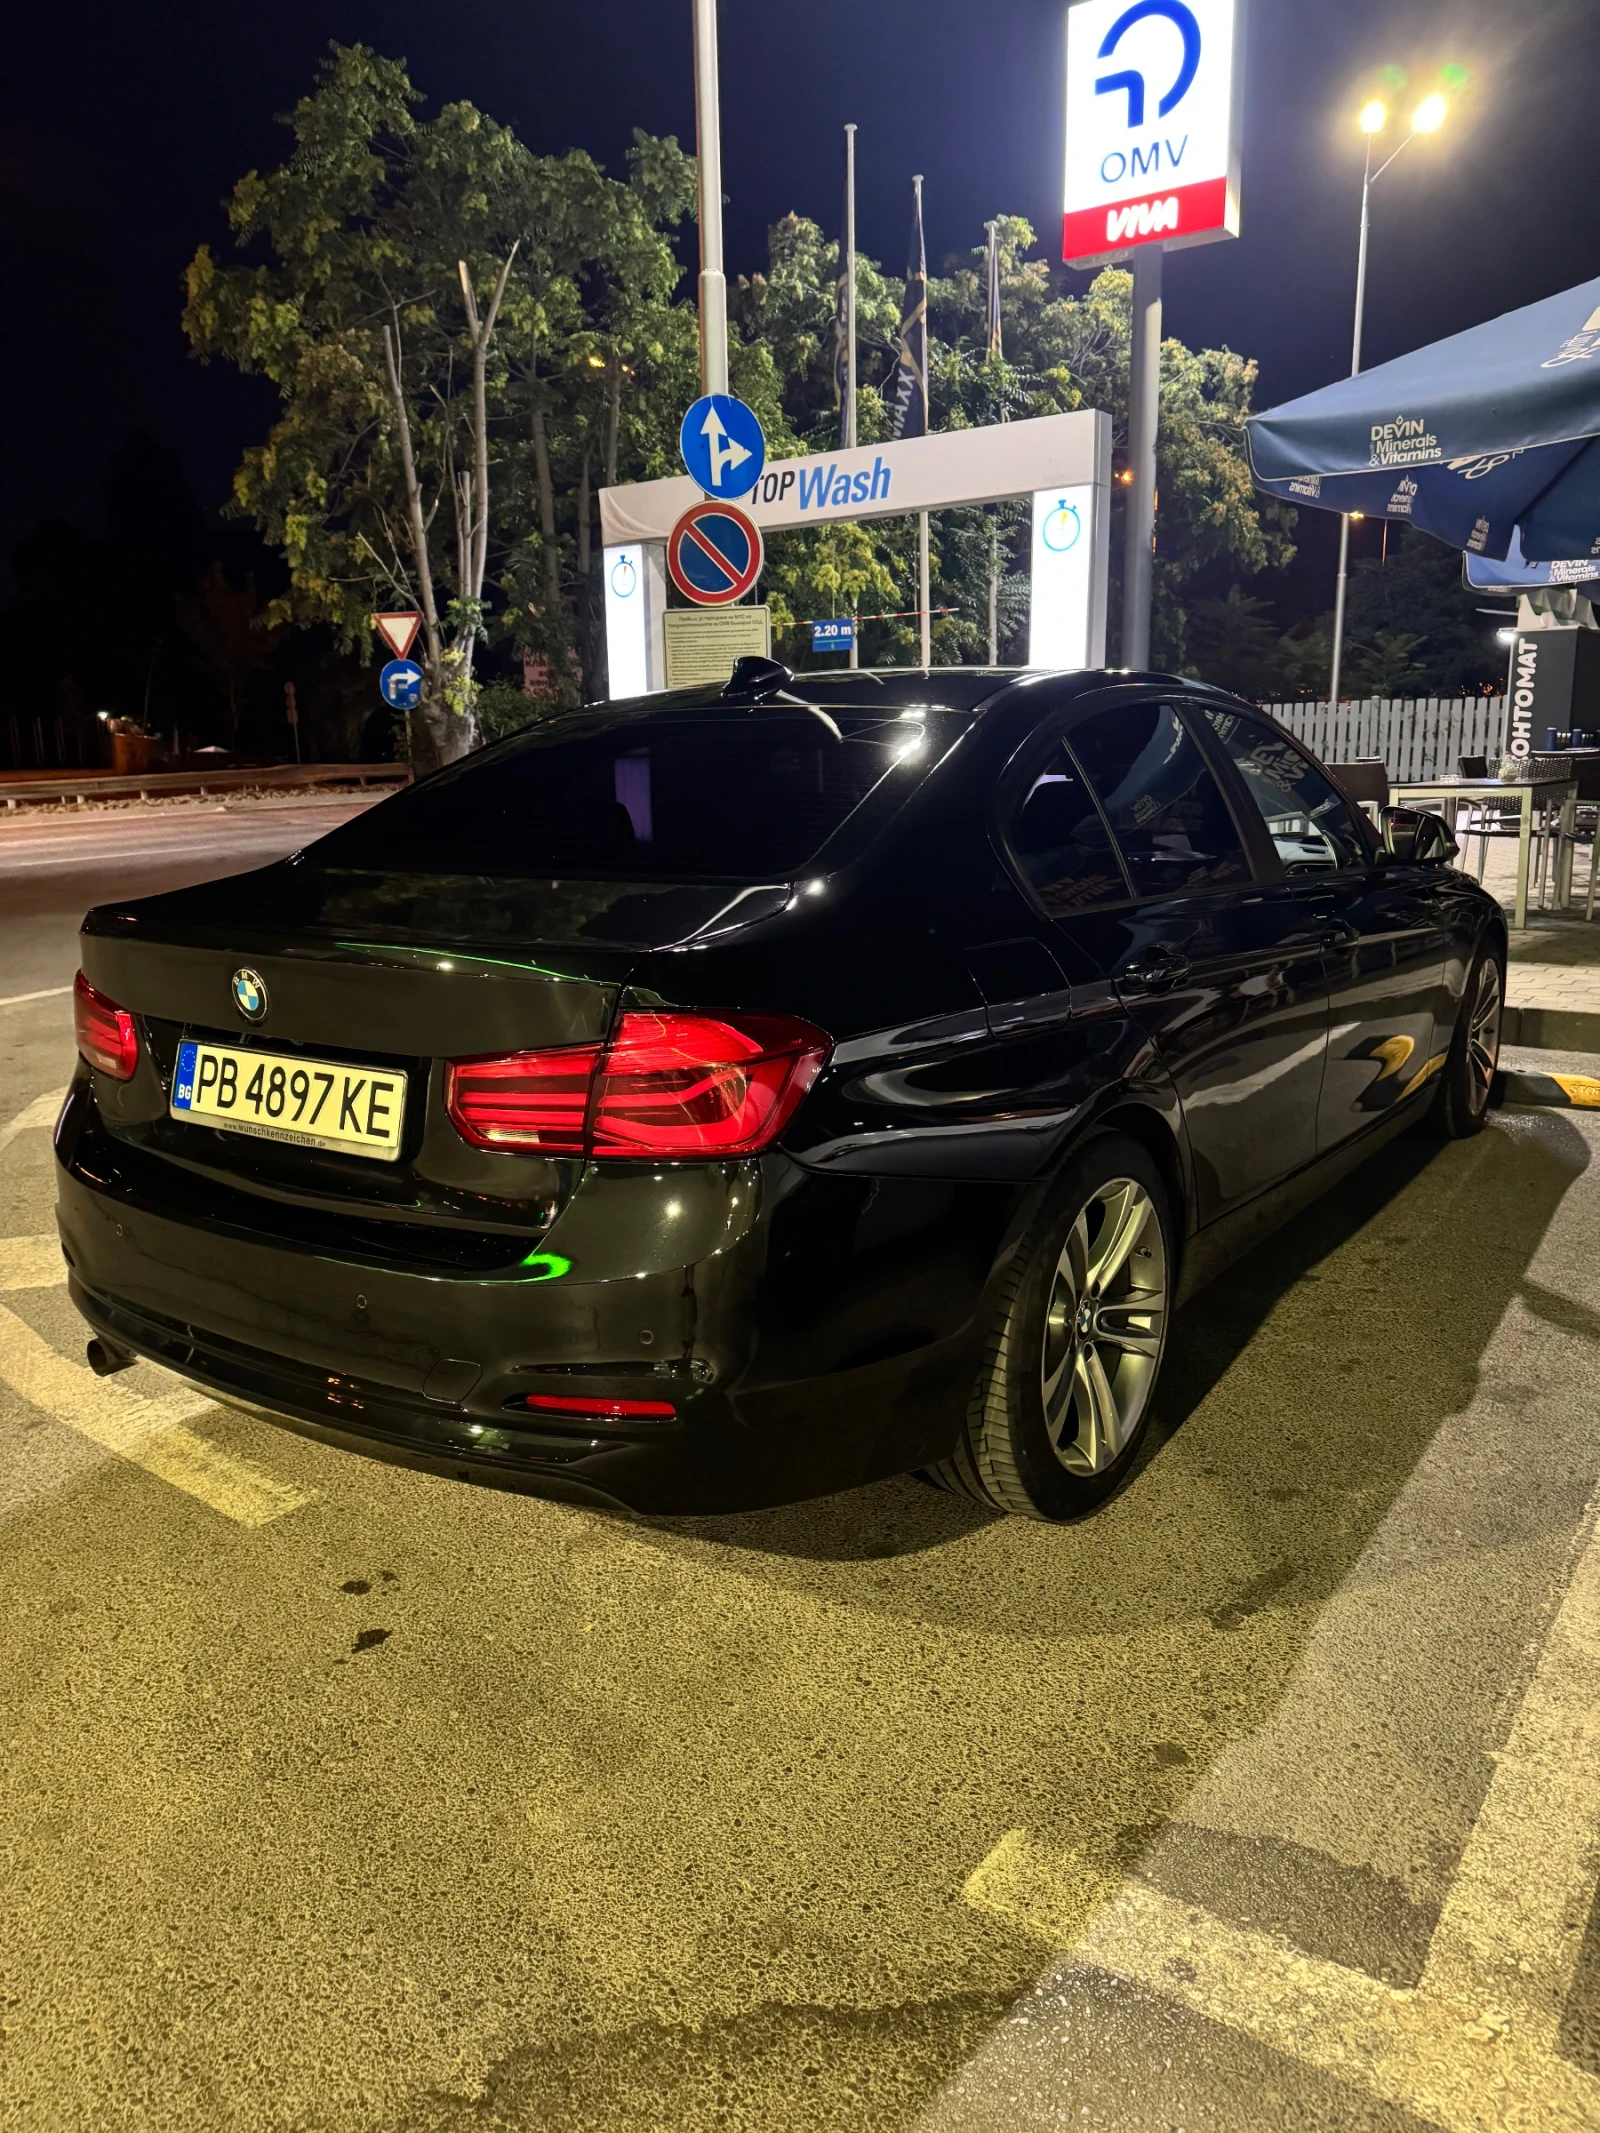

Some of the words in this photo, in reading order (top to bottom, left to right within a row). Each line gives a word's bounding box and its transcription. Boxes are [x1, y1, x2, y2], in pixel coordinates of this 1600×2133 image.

[1100, 134, 1189, 183] OMV
[1106, 196, 1179, 242] VIVA
[1370, 418, 1424, 441] DEVIN
[1375, 433, 1437, 454] Minerals
[1551, 559, 1589, 569] DEVIN
[1553, 565, 1597, 577] Minerals
[814, 624, 839, 638] 2.20
[840, 625, 852, 636] m
[1510, 638, 1538, 761] ОНТОМАТ
[232, 970, 261, 989] BMW
[177, 1083, 192, 1100] BG
